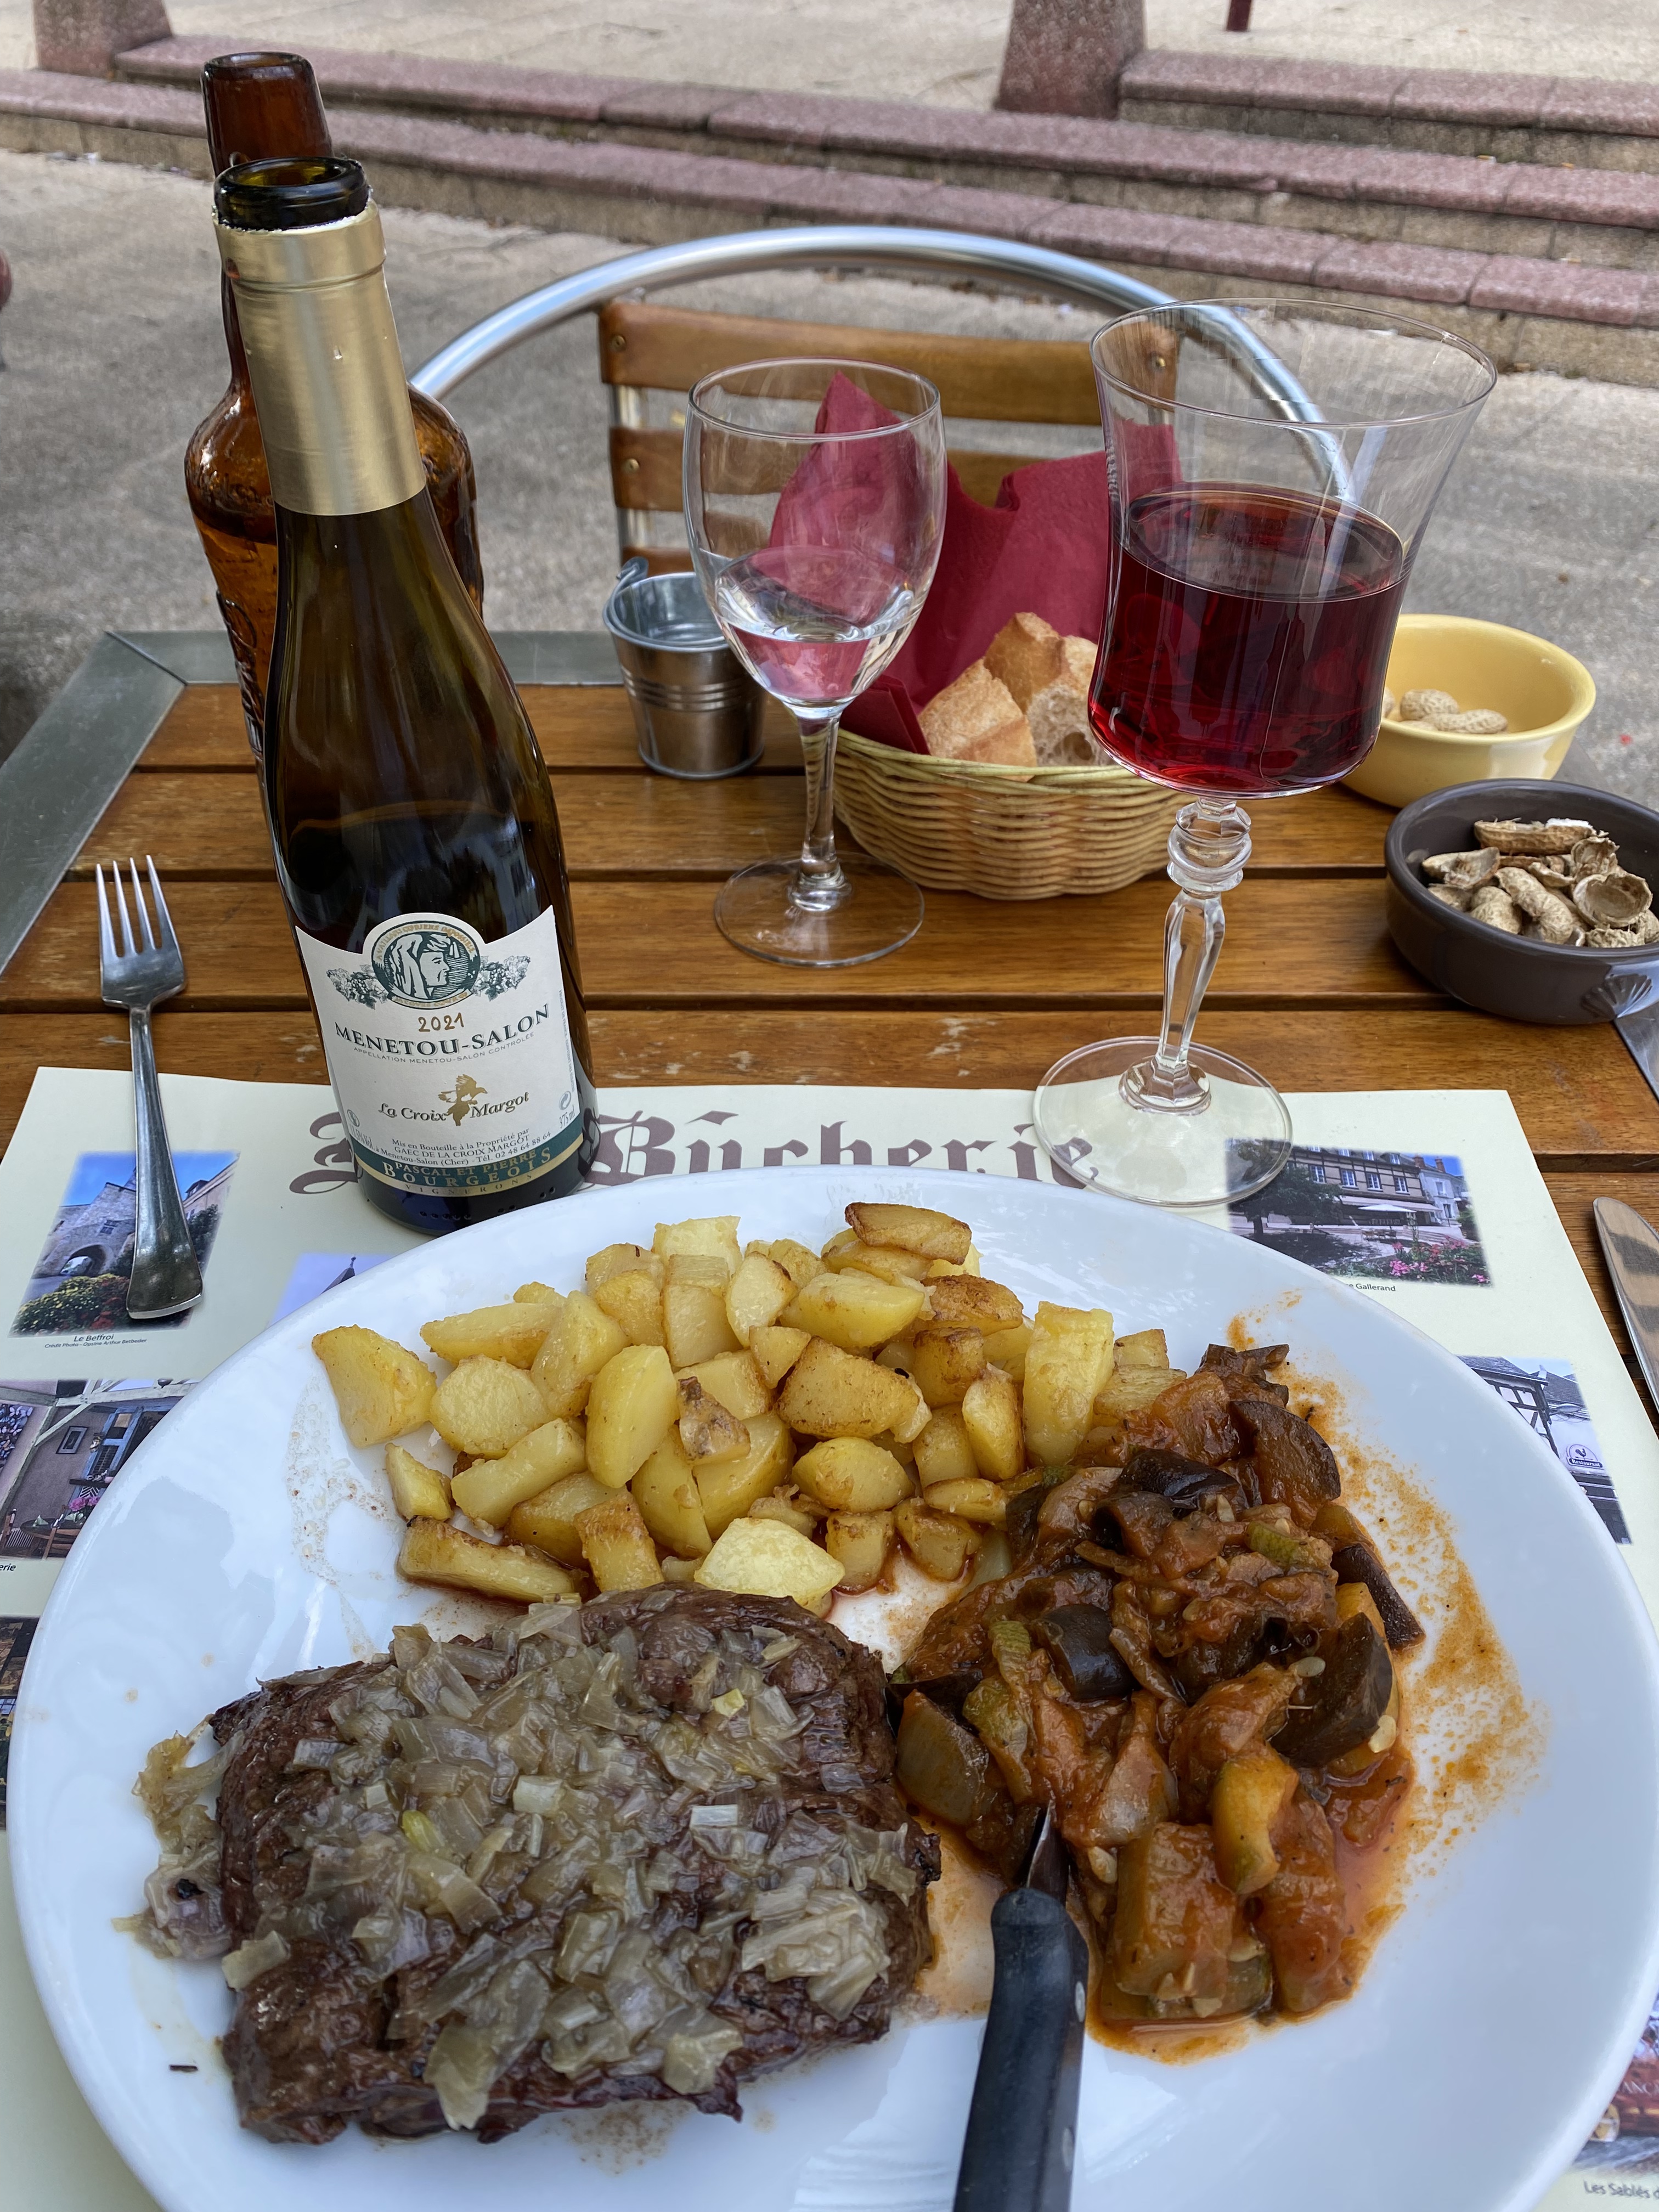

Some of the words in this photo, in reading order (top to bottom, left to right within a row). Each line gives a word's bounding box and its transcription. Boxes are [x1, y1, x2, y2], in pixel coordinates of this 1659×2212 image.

[335, 1003, 549, 1056] MENETOU-SALON
[418, 1012, 464, 1032] 2021
[354, 1047, 406, 1063] APPELLATION
[409, 1052, 485, 1064] MENETOU-SALON
[488, 1031, 534, 1054] CONTRÔLÉE
[378, 1103, 397, 1118] La
[401, 1108, 447, 1121] Croix
[470, 1091, 529, 1118] Margot
[558, 1113, 569, 1129] 375
[568, 1105, 575, 1120] ml
[381, 1148, 438, 1166] Menetou-Salon
[476, 1154, 493, 1163] Tél.
[532, 1137, 541, 1146] 88
[543, 1131, 551, 1139] 64
[392, 1138, 406, 1147] Mis
[420, 1143, 457, 1152] Bouteille
[476, 1132, 515, 1149] Propriété
[517, 1128, 529, 1140] par
[394, 1147, 419, 1156] GAEC
[453, 1148, 485, 1158] CROIX
[488, 1135, 529, 1153] MARGOT
[382, 1147, 551, 1187] BOURGEOIS
[395, 1162, 450, 1176] PASCAL
[456, 1166, 475, 1176] ET
[482, 1149, 537, 1173] PIERRE
[405, 1175, 532, 1194] VIGNERONS
[1356, 1283, 1396, 1291] Gallerand
[1583, 2180, 1606, 2194] Les
